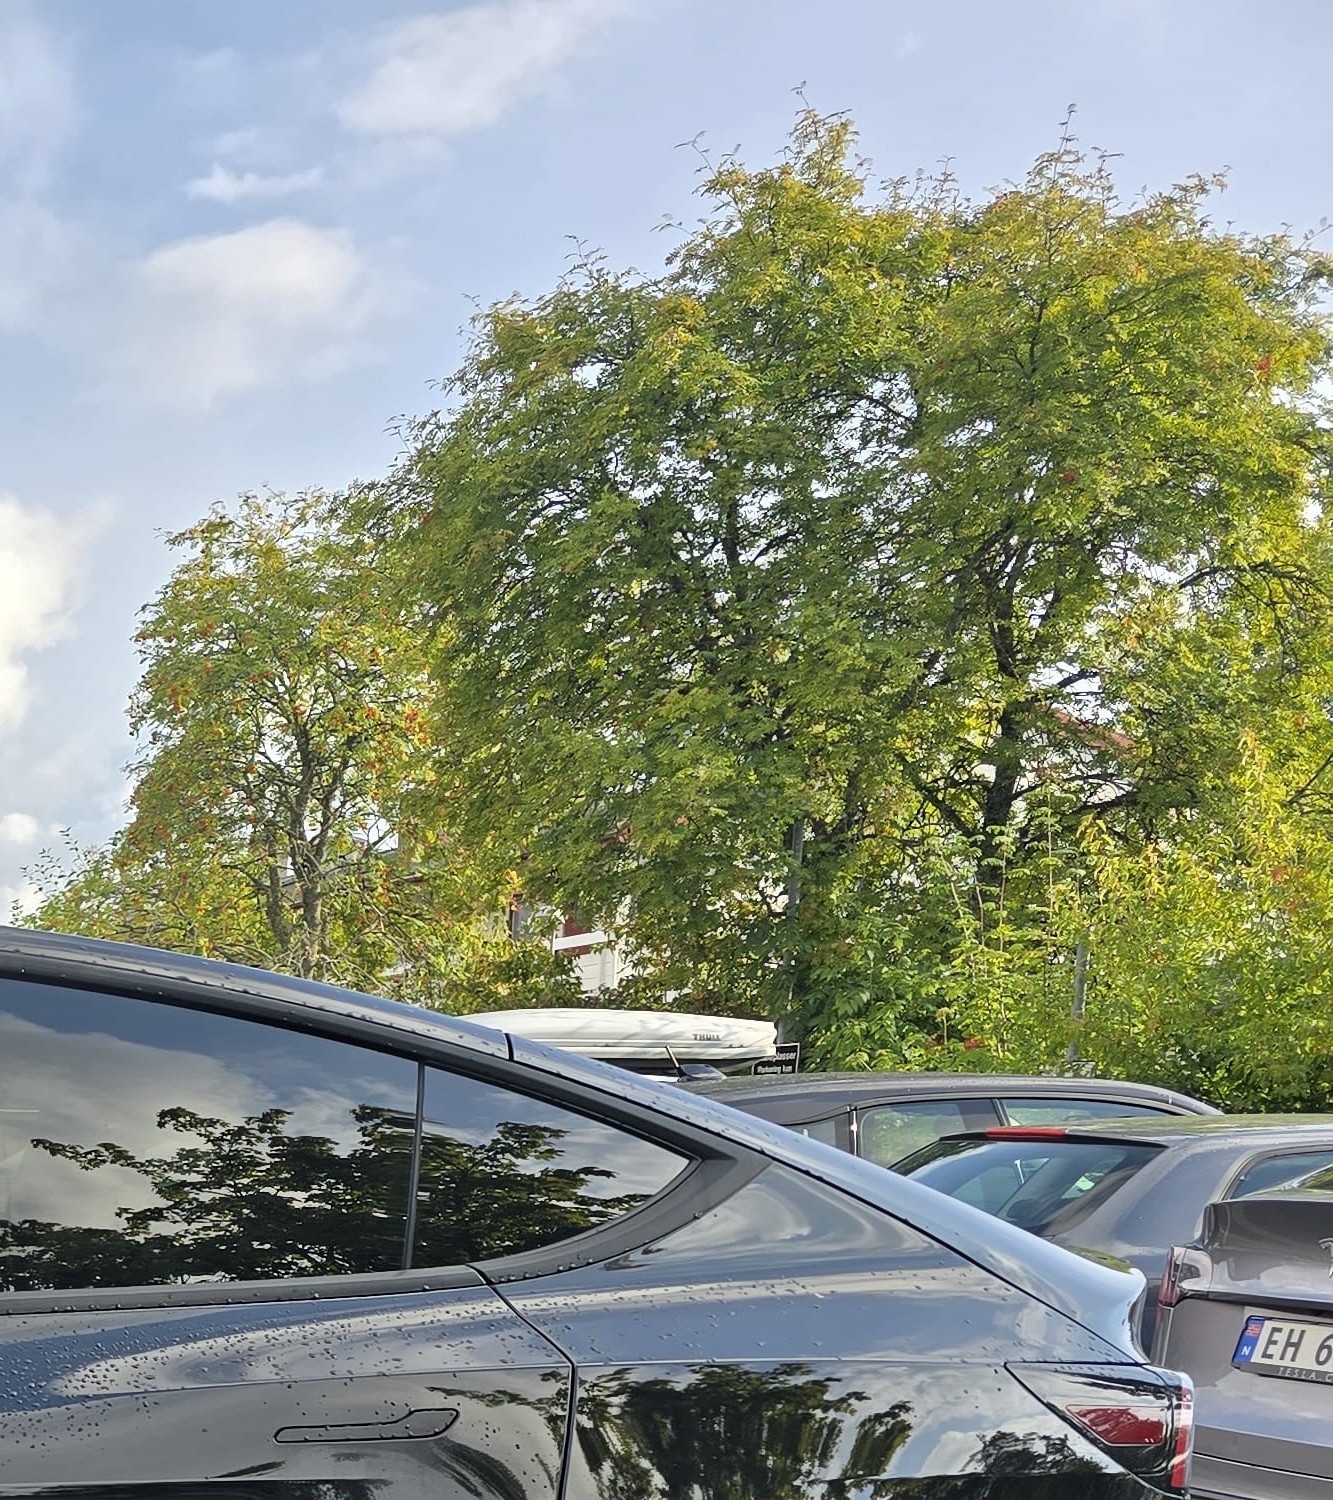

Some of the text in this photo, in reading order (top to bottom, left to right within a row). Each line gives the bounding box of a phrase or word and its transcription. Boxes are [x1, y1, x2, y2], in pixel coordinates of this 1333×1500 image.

[1241, 1345, 1252, 1356] N
[1260, 1326, 1333, 1366] EH 6
